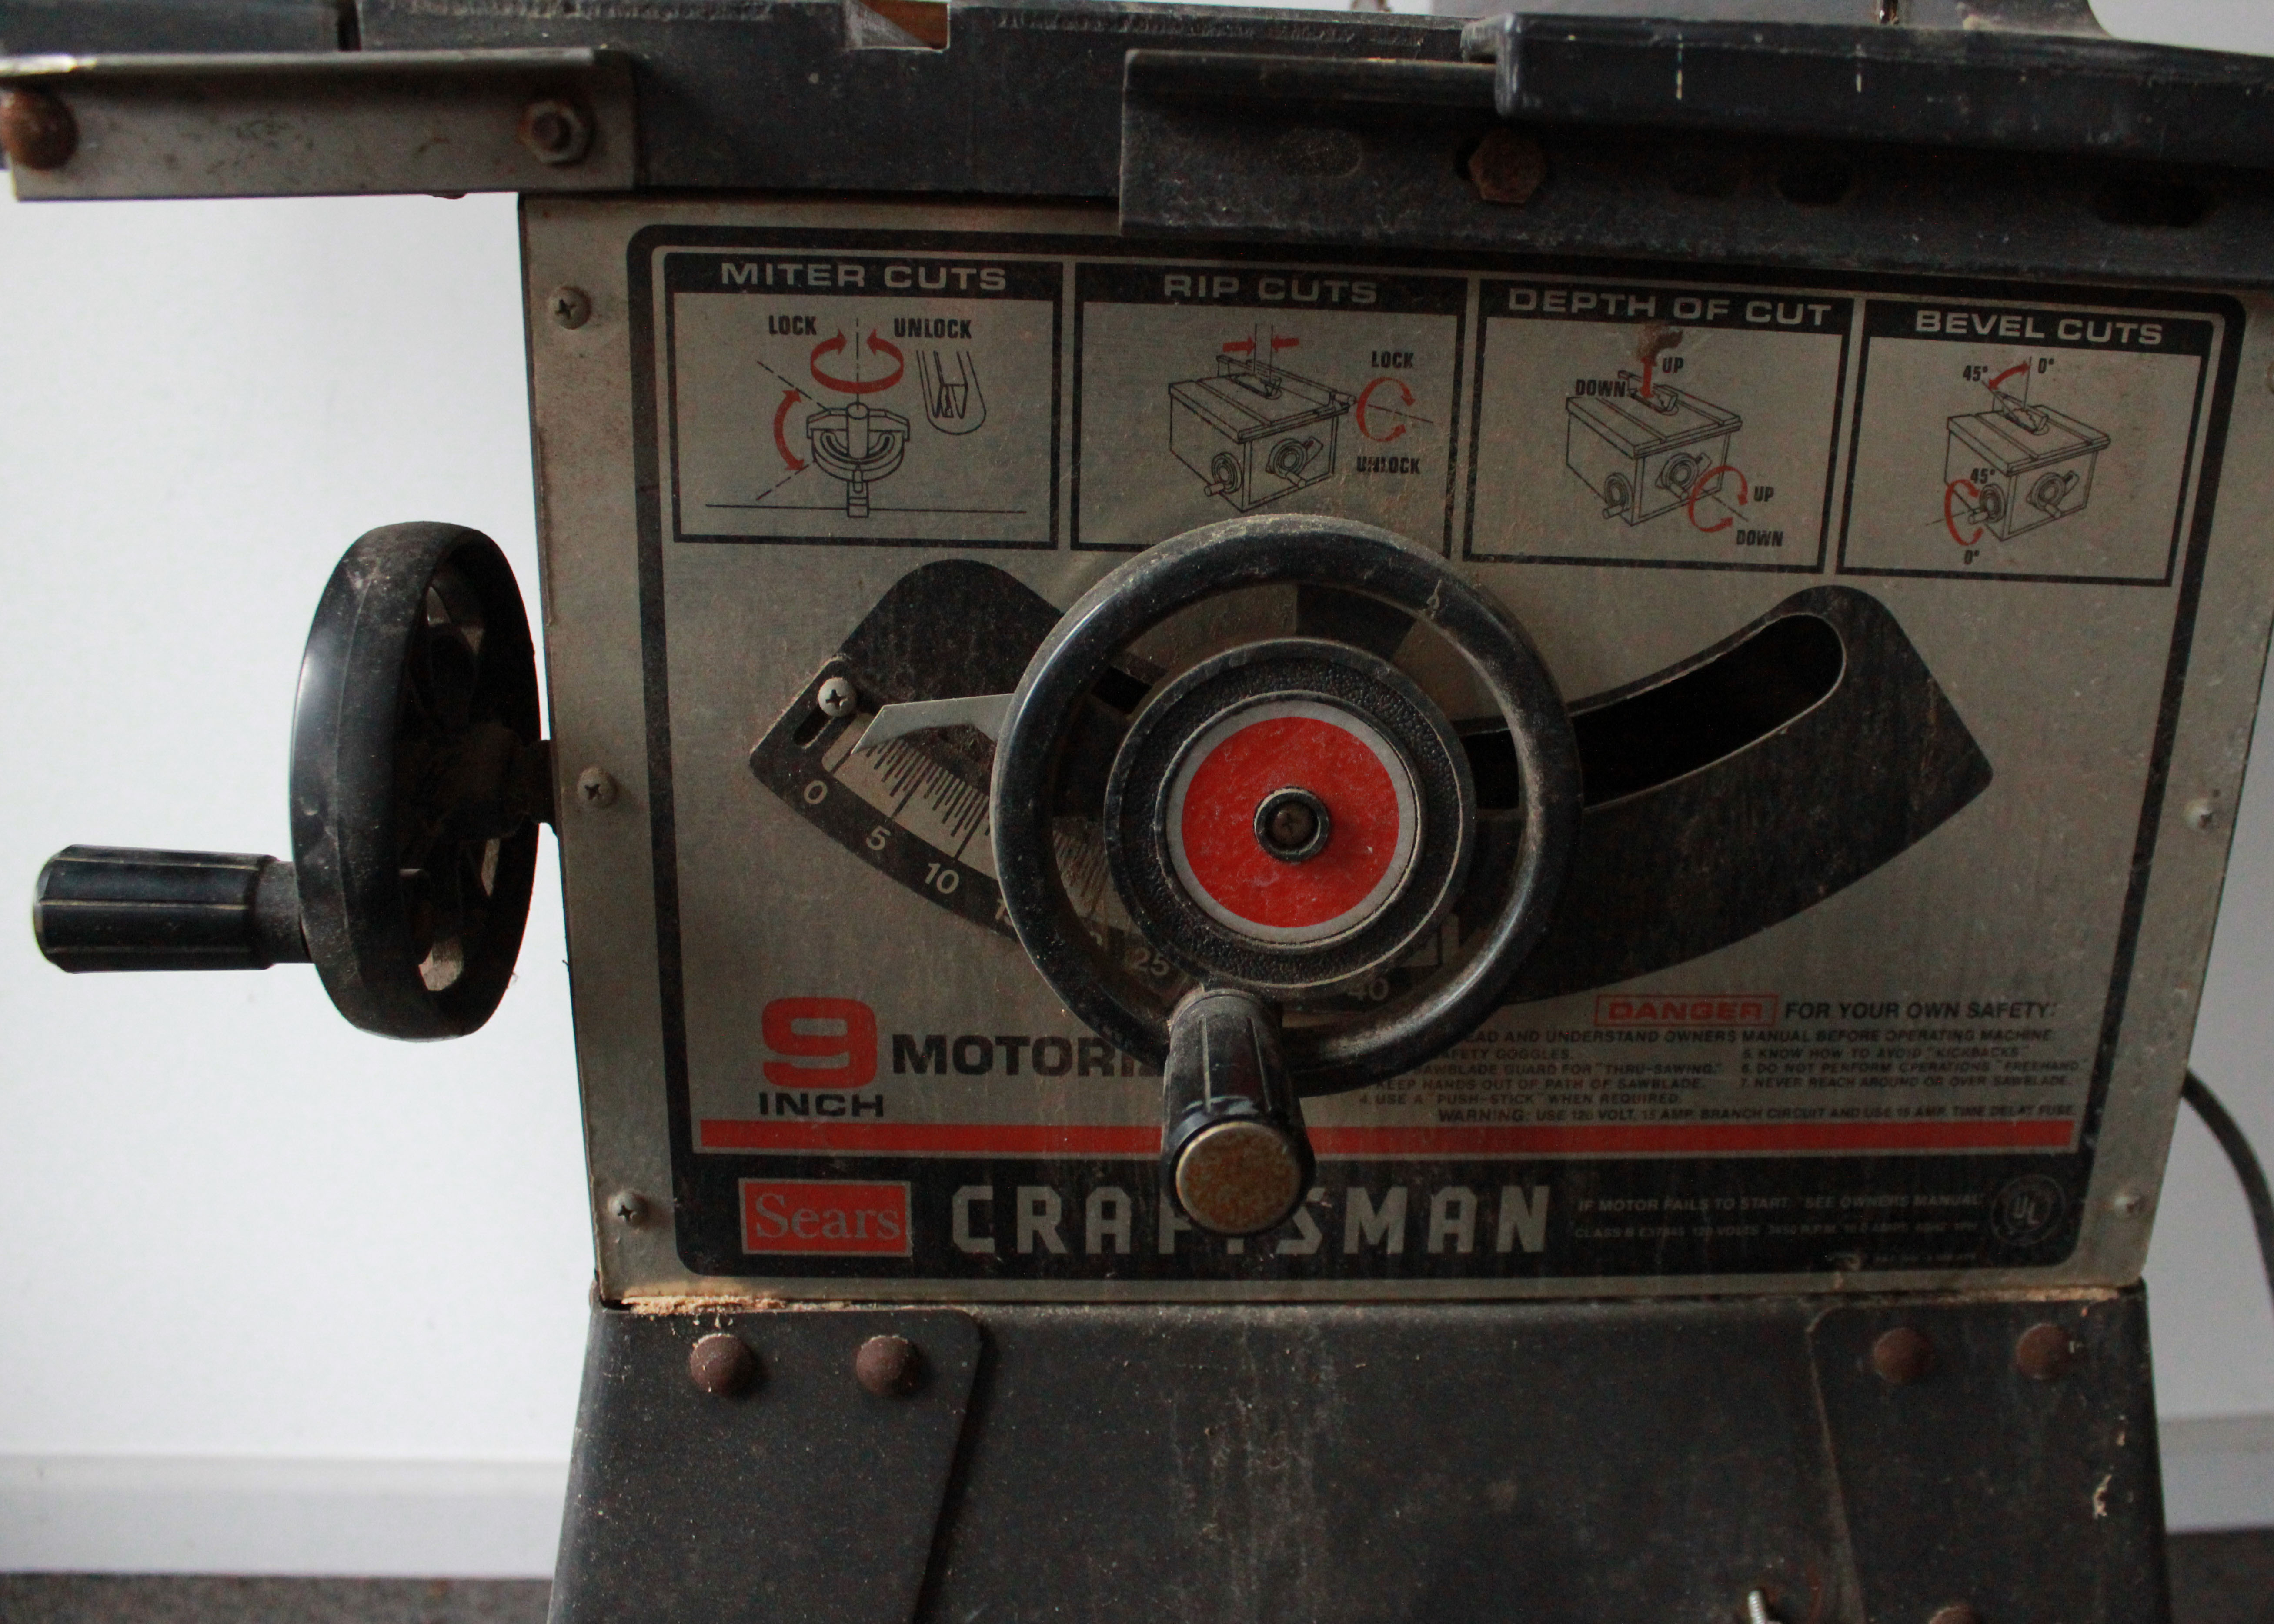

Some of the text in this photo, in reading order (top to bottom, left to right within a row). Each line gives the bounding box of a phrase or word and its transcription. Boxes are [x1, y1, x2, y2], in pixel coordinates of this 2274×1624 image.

[721, 263, 1007, 291] MITER CUTS
[1164, 274, 1378, 303] RIP CUTS
[1508, 287, 1832, 326] DEPTH OF CUT
[768, 315, 817, 335] LOCK
[894, 318, 972, 339] UNLOCK
[1915, 310, 2164, 345] BEVEL CUTS
[1372, 351, 1415, 369] LOCK
[1662, 357, 1684, 373] UP
[2038, 358, 2054, 374] 0°
[1963, 365, 1989, 381] 45°
[1575, 379, 1626, 398] DOWN
[1356, 456, 1421, 475] UNLOCK
[1970, 468, 1996, 484] 45°
[1754, 486, 1774, 503] UP
[1736, 530, 1784, 547] DOWN
[1964, 550, 1980, 565] 0°
[804, 780, 827, 804] 0
[866, 826, 891, 851] 5
[924, 862, 959, 894] 10
[1129, 947, 1170, 976] 25
[1609, 1002, 1763, 1020] DANGER
[1785, 1002, 1830, 1019] FOR
[1839, 1002, 1899, 1019] YOUR
[1907, 1002, 1960, 1019] OWN
[761, 997, 878, 1089] 9
[1504, 1030, 1540, 1042] AND
[1545, 1030, 1659, 1042] UNDERSTAND
[1663, 1030, 1736, 1042] OWNERS
[1742, 1030, 1810, 1042] MANUAL
[1816, 1030, 1880, 1042] BEFORE
[759, 1093, 884, 1117] INCH
[1537, 1110, 1566, 1120] USE
[1599, 1200, 1659, 1211] MOTOR
[1715, 1198, 1735, 1210] TO
[755, 1193, 901, 1239] Sears
[952, 1185, 1550, 1255] CRAFSMAN
